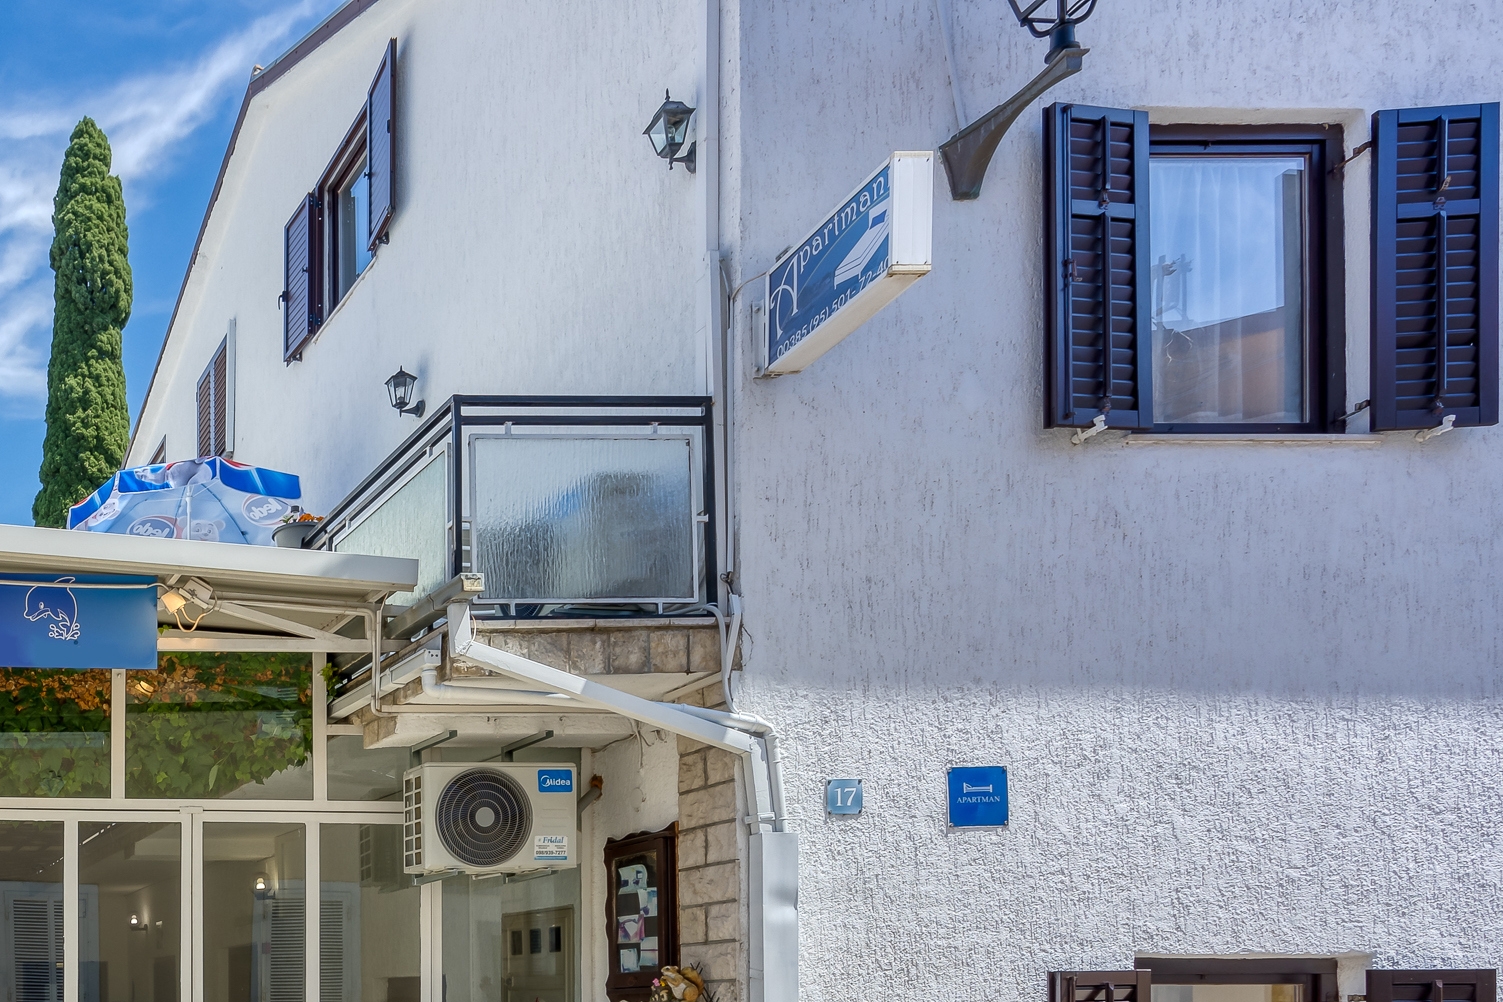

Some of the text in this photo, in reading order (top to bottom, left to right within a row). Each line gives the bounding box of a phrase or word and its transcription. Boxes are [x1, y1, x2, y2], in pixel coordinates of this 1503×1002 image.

[777, 324, 808, 358] 00385
[809, 307, 829, 332] (95)
[542, 776, 571, 787] Midea
[834, 788, 857, 807] 17
[957, 796, 1001, 804] APARTMAN
